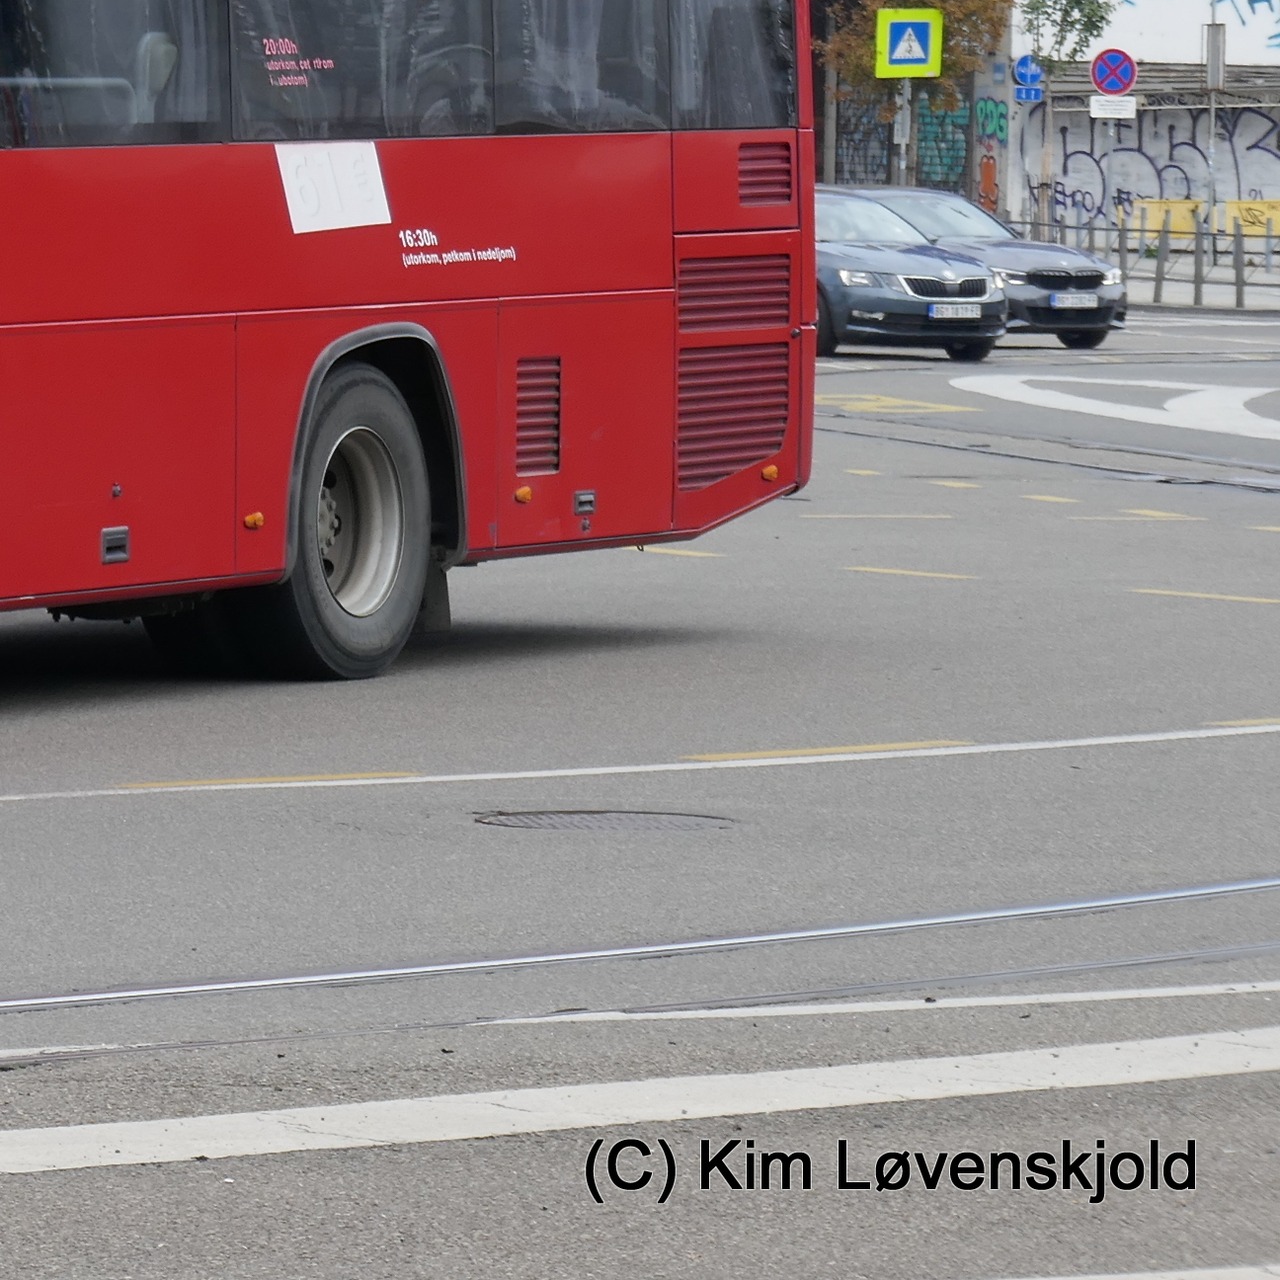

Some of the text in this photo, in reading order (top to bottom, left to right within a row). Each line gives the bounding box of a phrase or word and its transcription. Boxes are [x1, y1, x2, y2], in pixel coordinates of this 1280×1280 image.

[262, 38, 298, 55] 20:00h
[398, 228, 438, 247] 16:30h
[402, 246, 516, 268] (utorkom, petkom i nedeljom)
